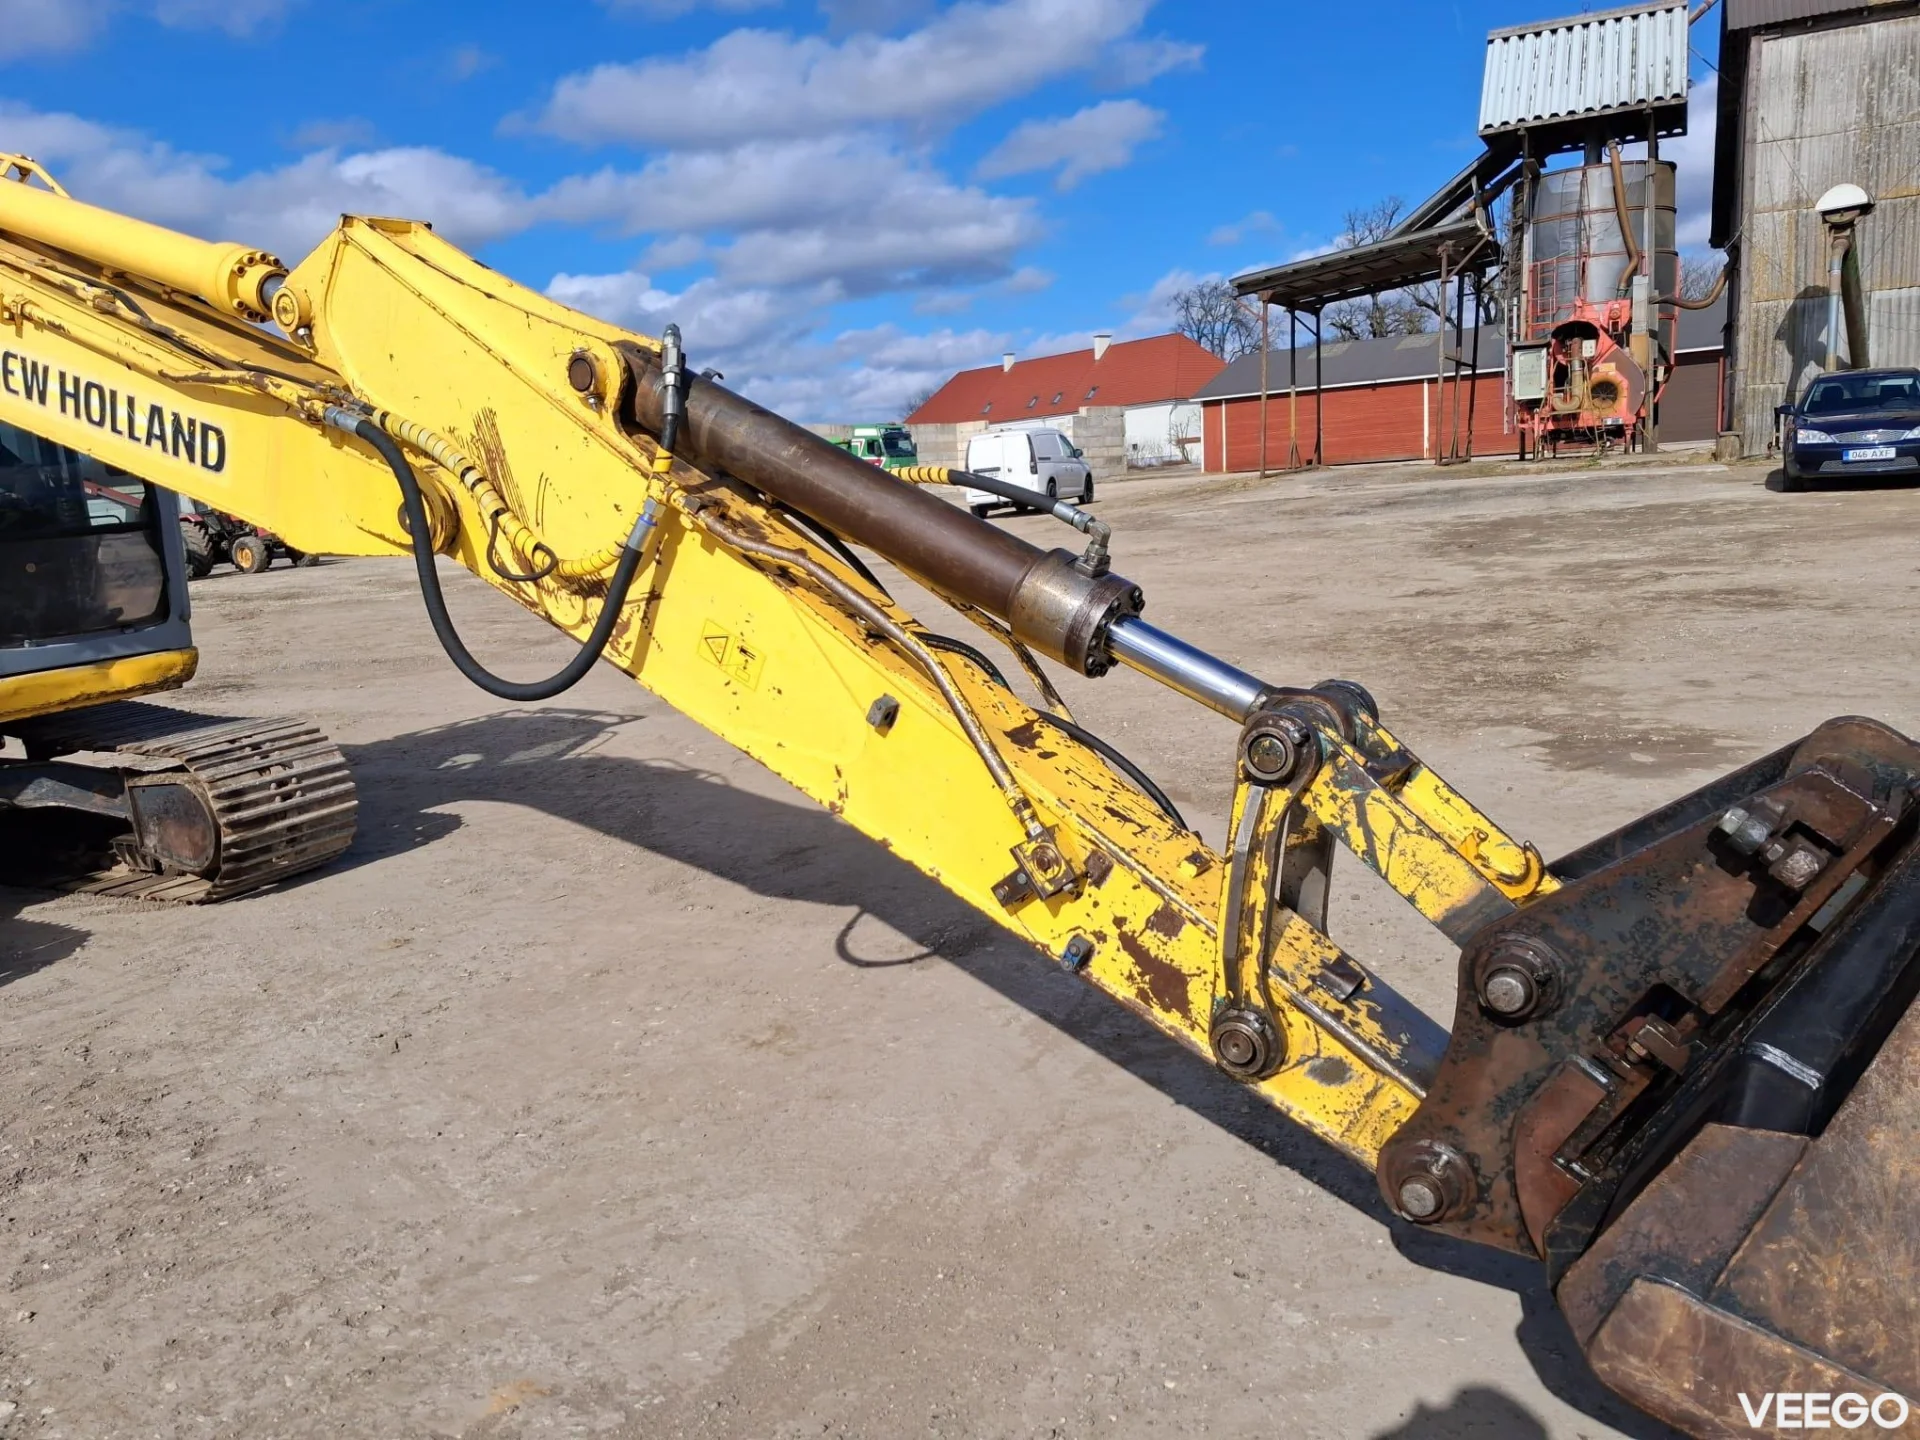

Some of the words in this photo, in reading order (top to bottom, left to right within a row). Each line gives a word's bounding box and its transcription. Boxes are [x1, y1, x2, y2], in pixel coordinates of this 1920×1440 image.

[58, 369, 226, 473] HOLLAND
[1851, 450, 1868, 459] 046
[1870, 449, 1891, 458] AXF
